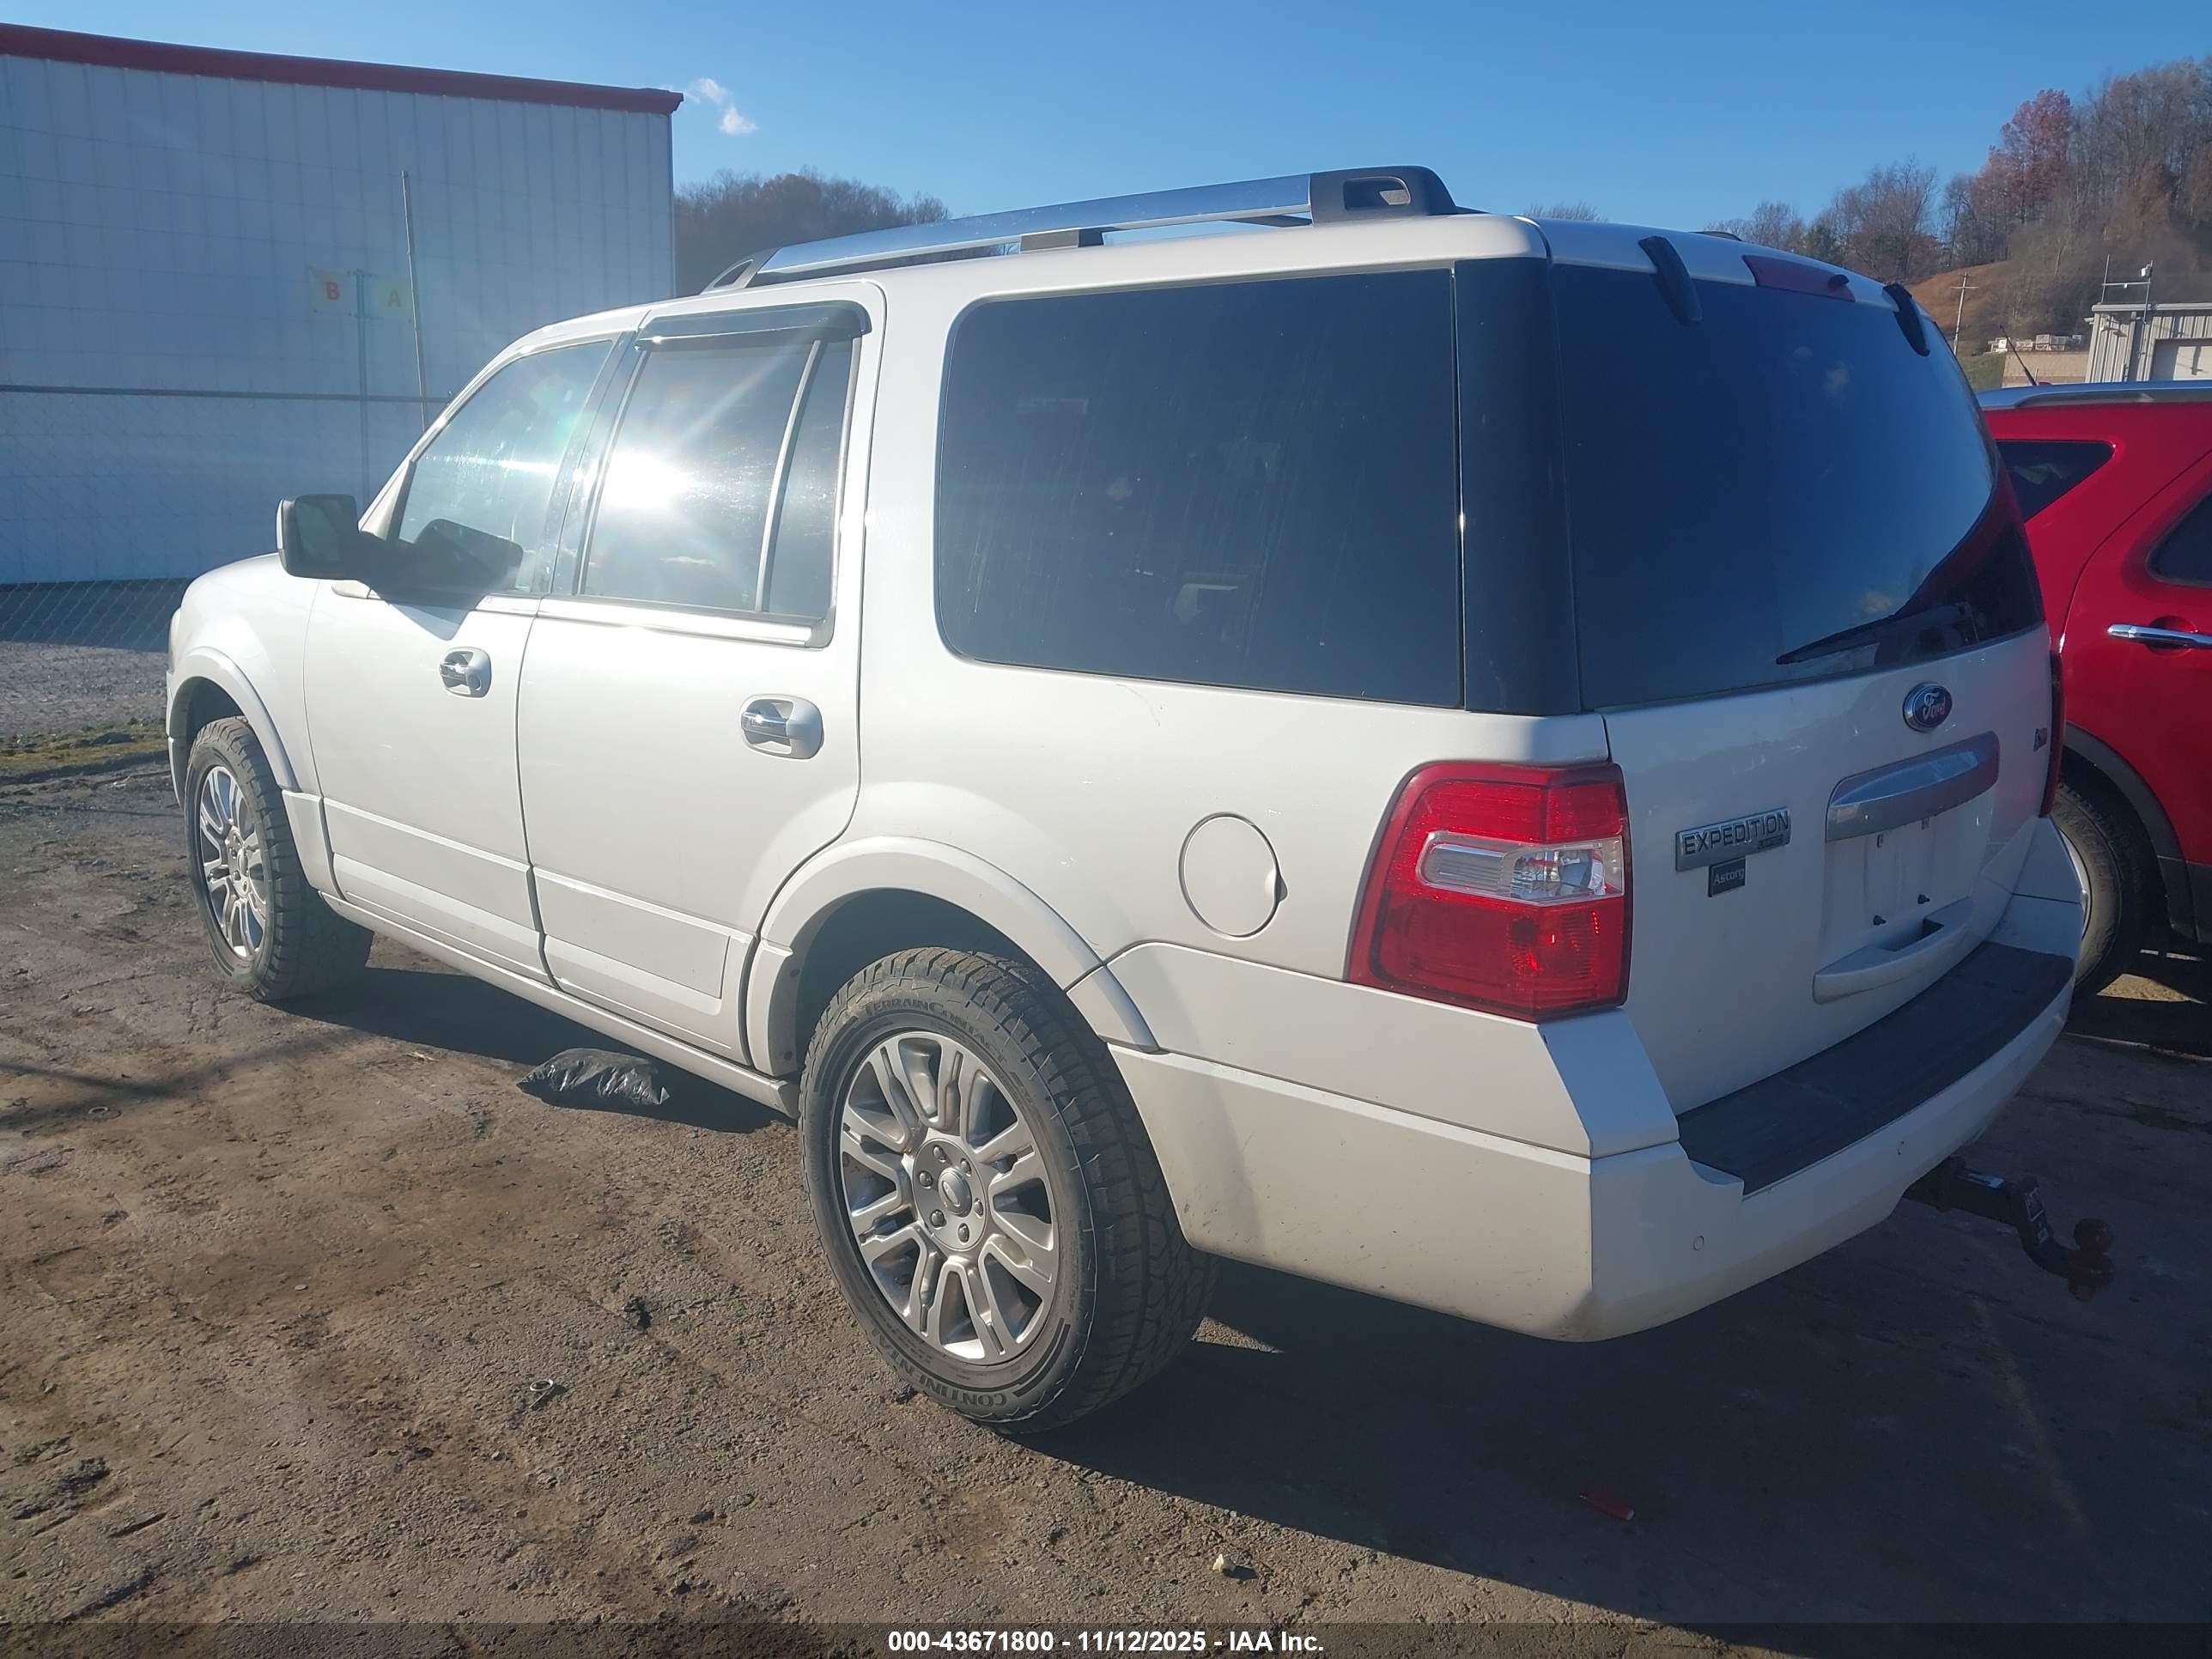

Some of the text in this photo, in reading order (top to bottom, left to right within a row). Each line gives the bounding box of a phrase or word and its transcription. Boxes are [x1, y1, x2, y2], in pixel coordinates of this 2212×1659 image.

[325, 282, 340, 301] B
[388, 289, 402, 307] A
[1923, 692, 1946, 720] Ford
[1684, 811, 1789, 855] EXPEDITION
